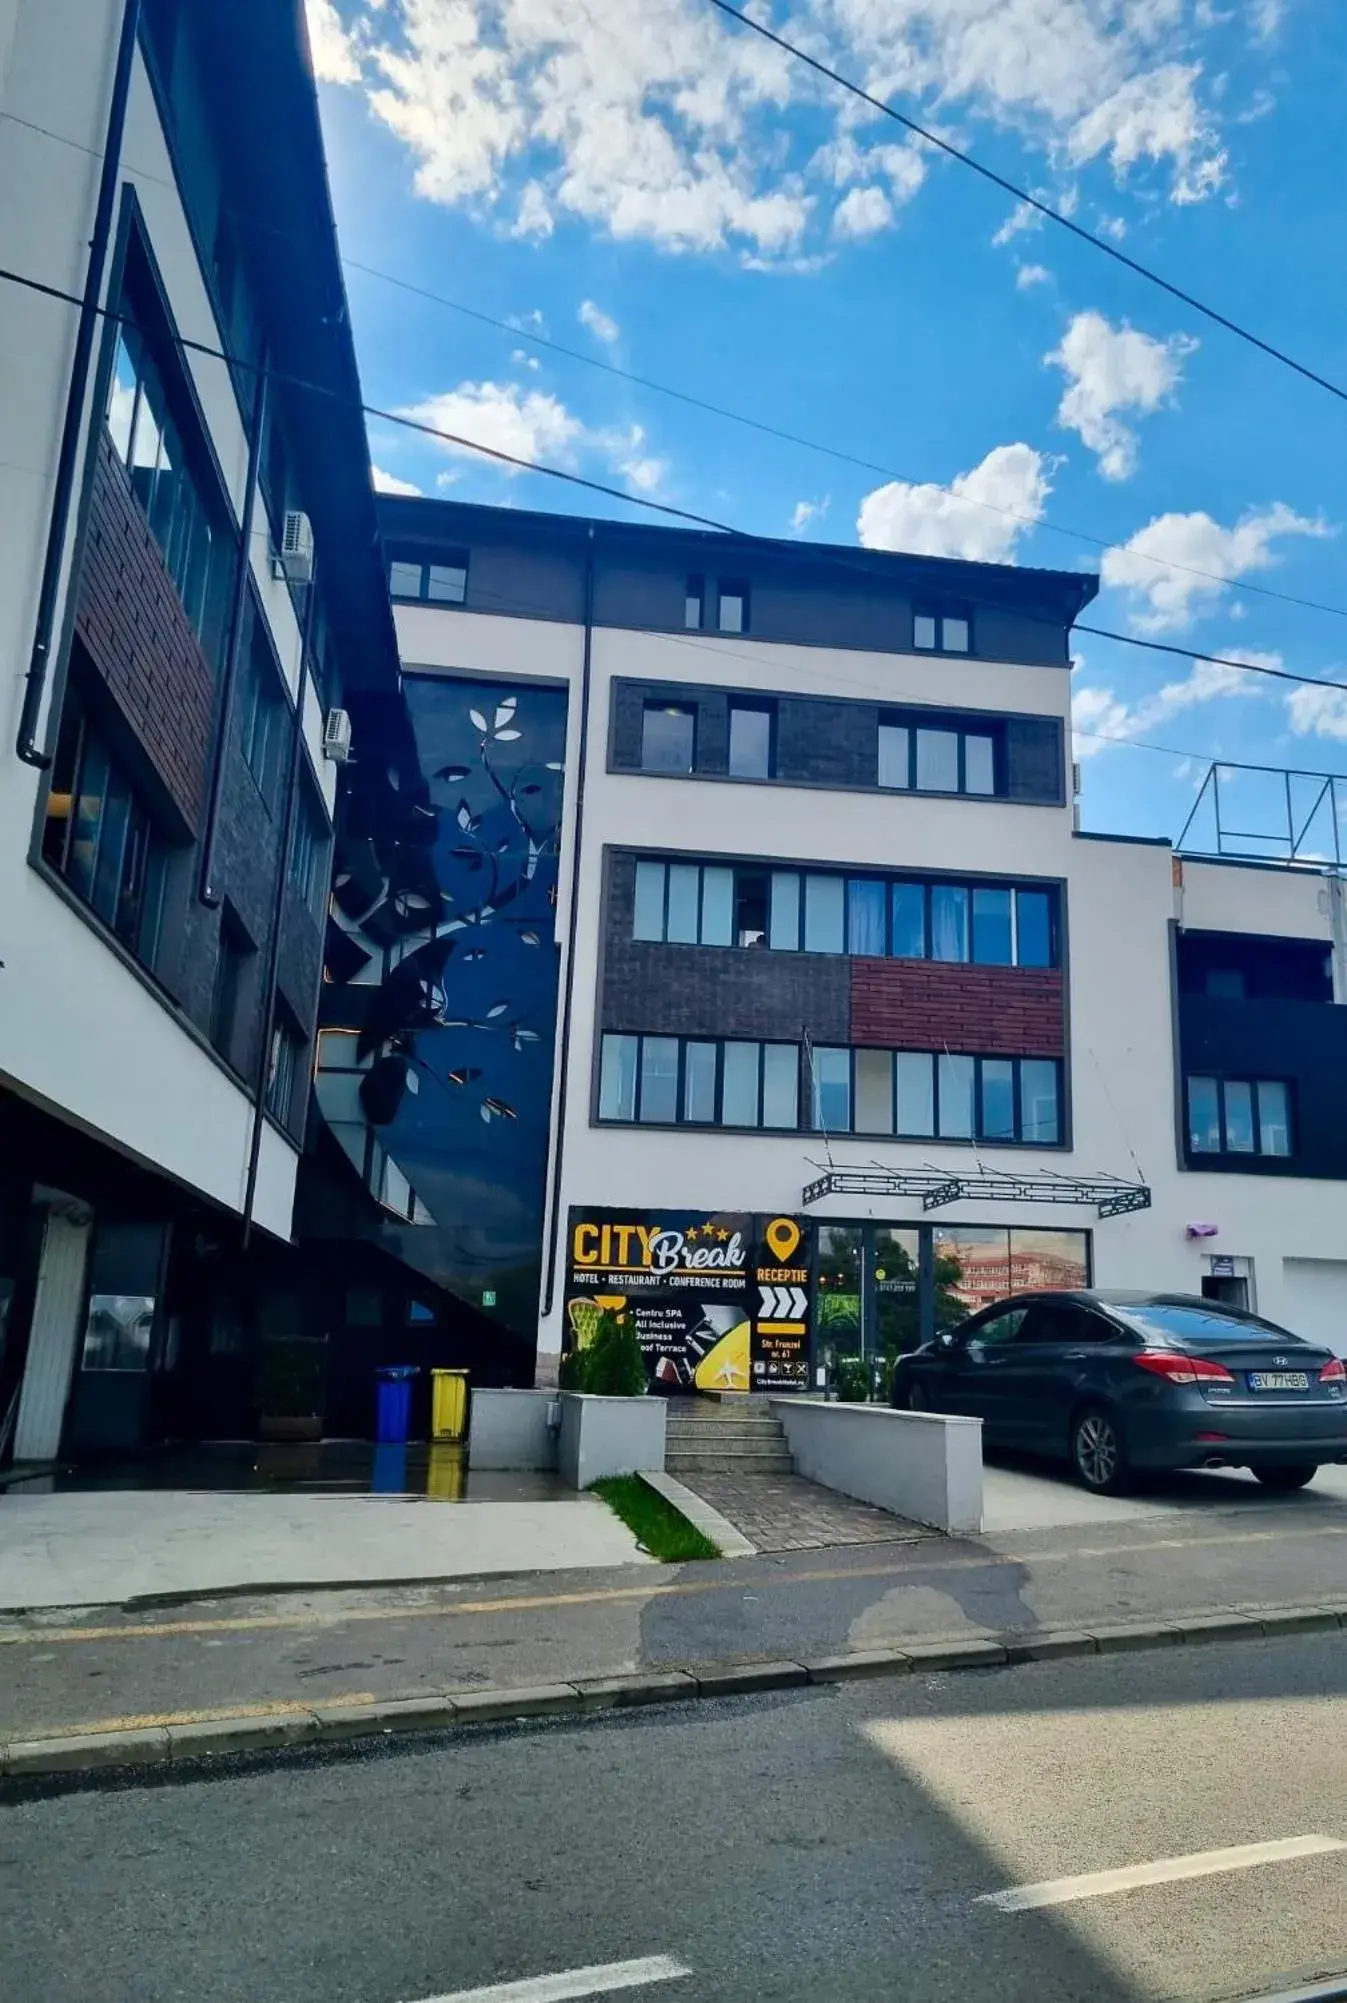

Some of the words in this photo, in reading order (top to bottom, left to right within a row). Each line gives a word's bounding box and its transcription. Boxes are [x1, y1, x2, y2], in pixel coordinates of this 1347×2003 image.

[574, 1223, 661, 1266] CITY
[648, 1231, 746, 1275] Break
[573, 1272, 599, 1283] HOTEL
[608, 1274, 661, 1286] RESTAURANT
[669, 1276, 721, 1288] CONFERENCE
[722, 1278, 746, 1289] ROOM
[757, 1268, 808, 1283] RECEPTIE
[635, 1308, 664, 1317] Centru
[665, 1309, 683, 1318] SPA
[635, 1320, 647, 1328] All
[649, 1320, 687, 1329] Inclusive
[655, 1344, 687, 1352] Terrace
